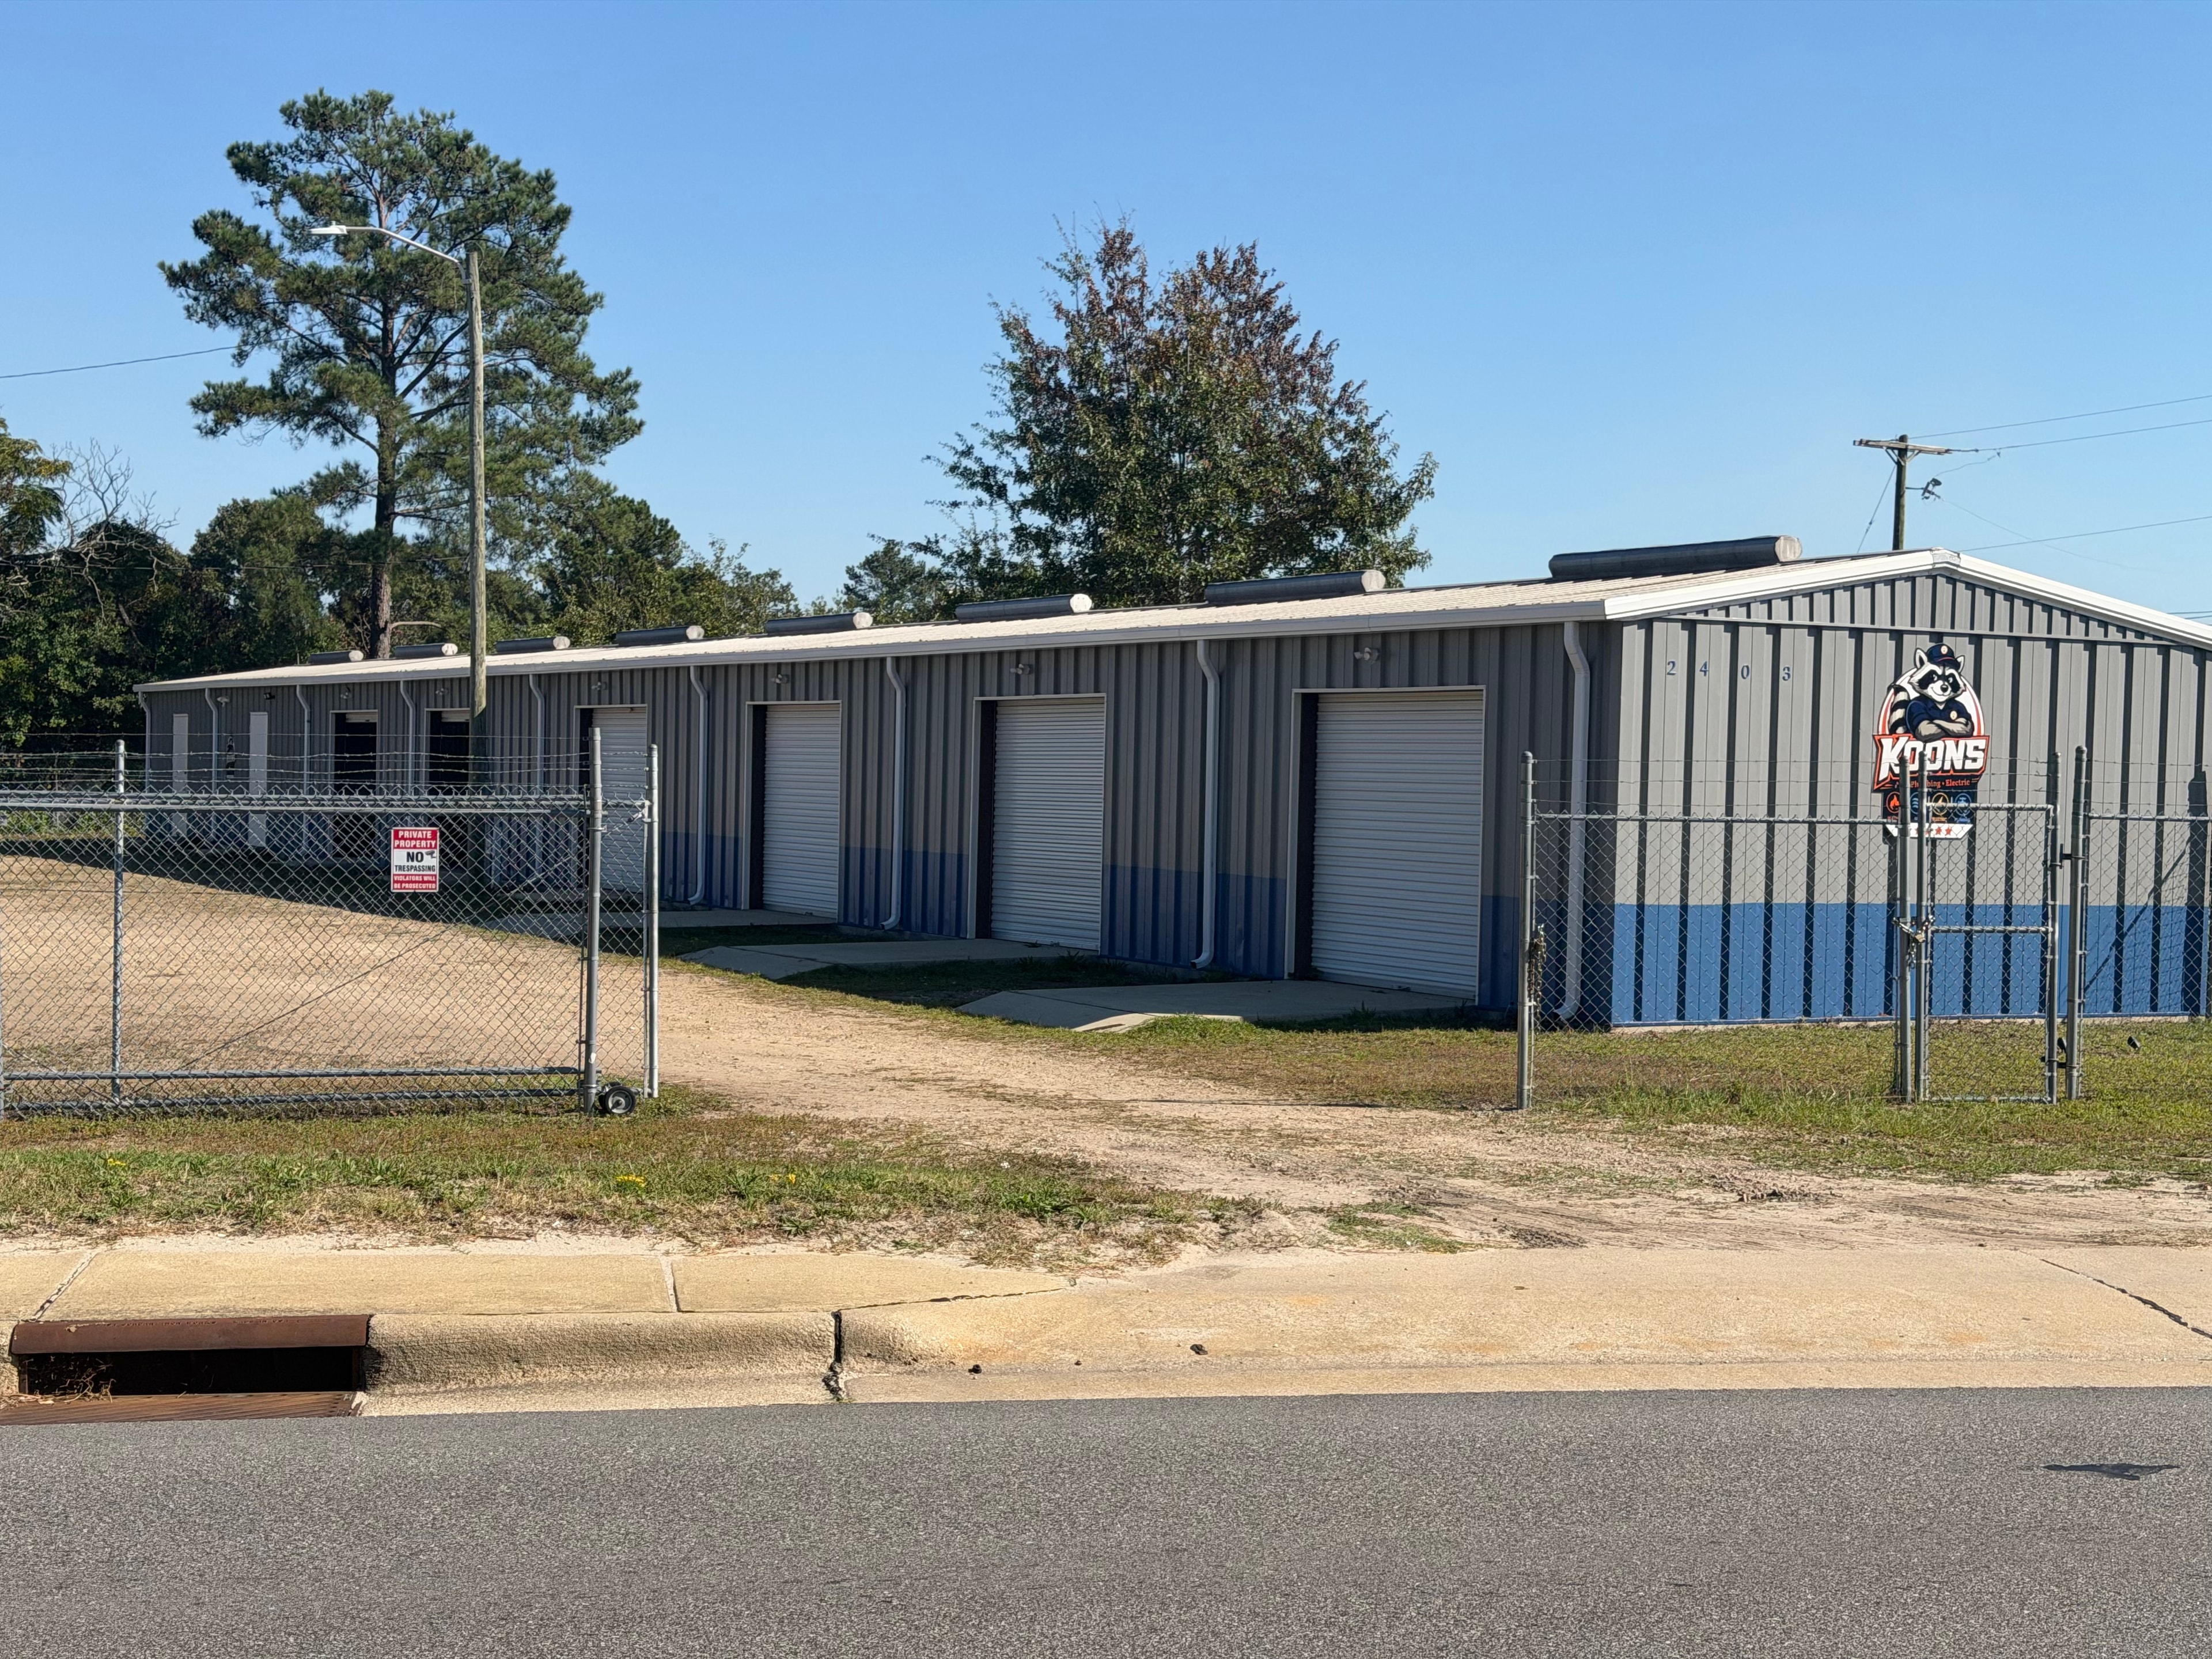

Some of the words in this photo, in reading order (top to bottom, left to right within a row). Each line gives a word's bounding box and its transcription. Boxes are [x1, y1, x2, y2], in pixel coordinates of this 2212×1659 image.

[1666, 660, 1791, 681] 2403
[1878, 736, 1986, 782] KOONS
[1945, 778, 1970, 787] Electric
[398, 831, 432, 839] PRIVATE
[394, 840, 436, 848] PROPERTY
[406, 851, 424, 863] NO
